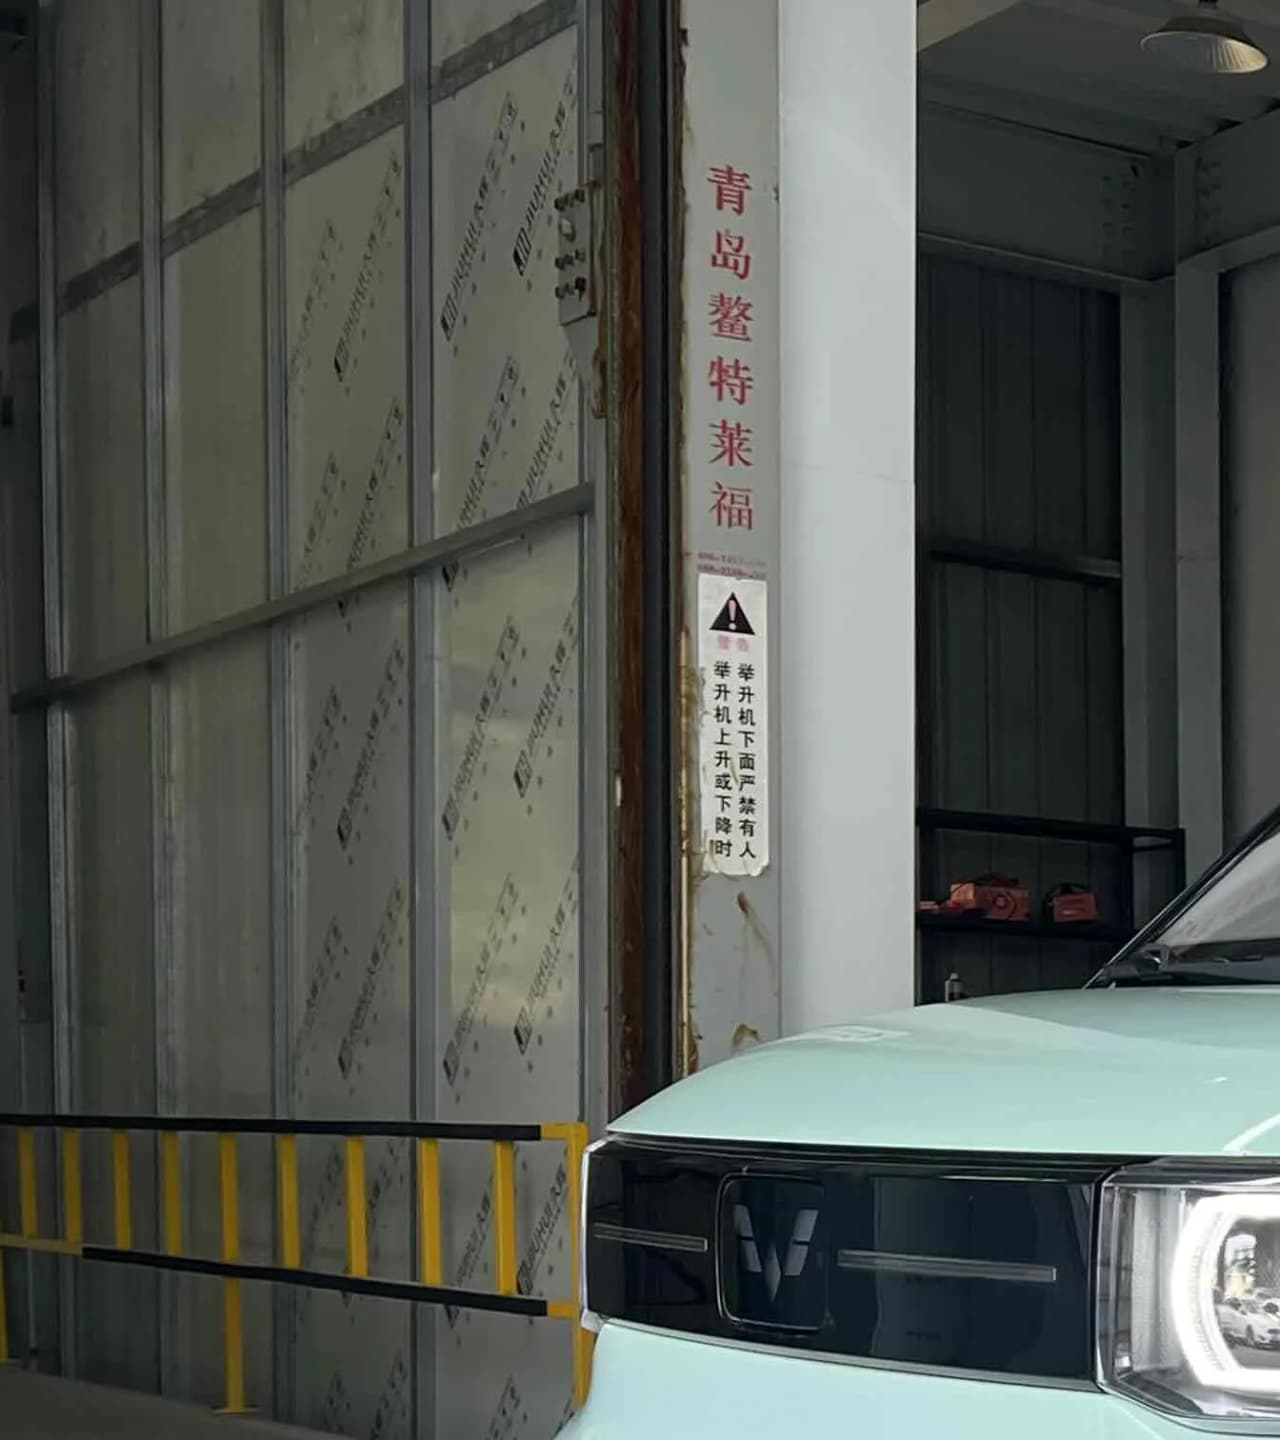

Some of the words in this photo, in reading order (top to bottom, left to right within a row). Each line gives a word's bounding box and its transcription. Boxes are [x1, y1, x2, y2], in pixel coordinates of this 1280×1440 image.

[711, 660, 732, 858] 举升机上升或下降时
[738, 663, 757, 860] 举升机下面严禁有人
